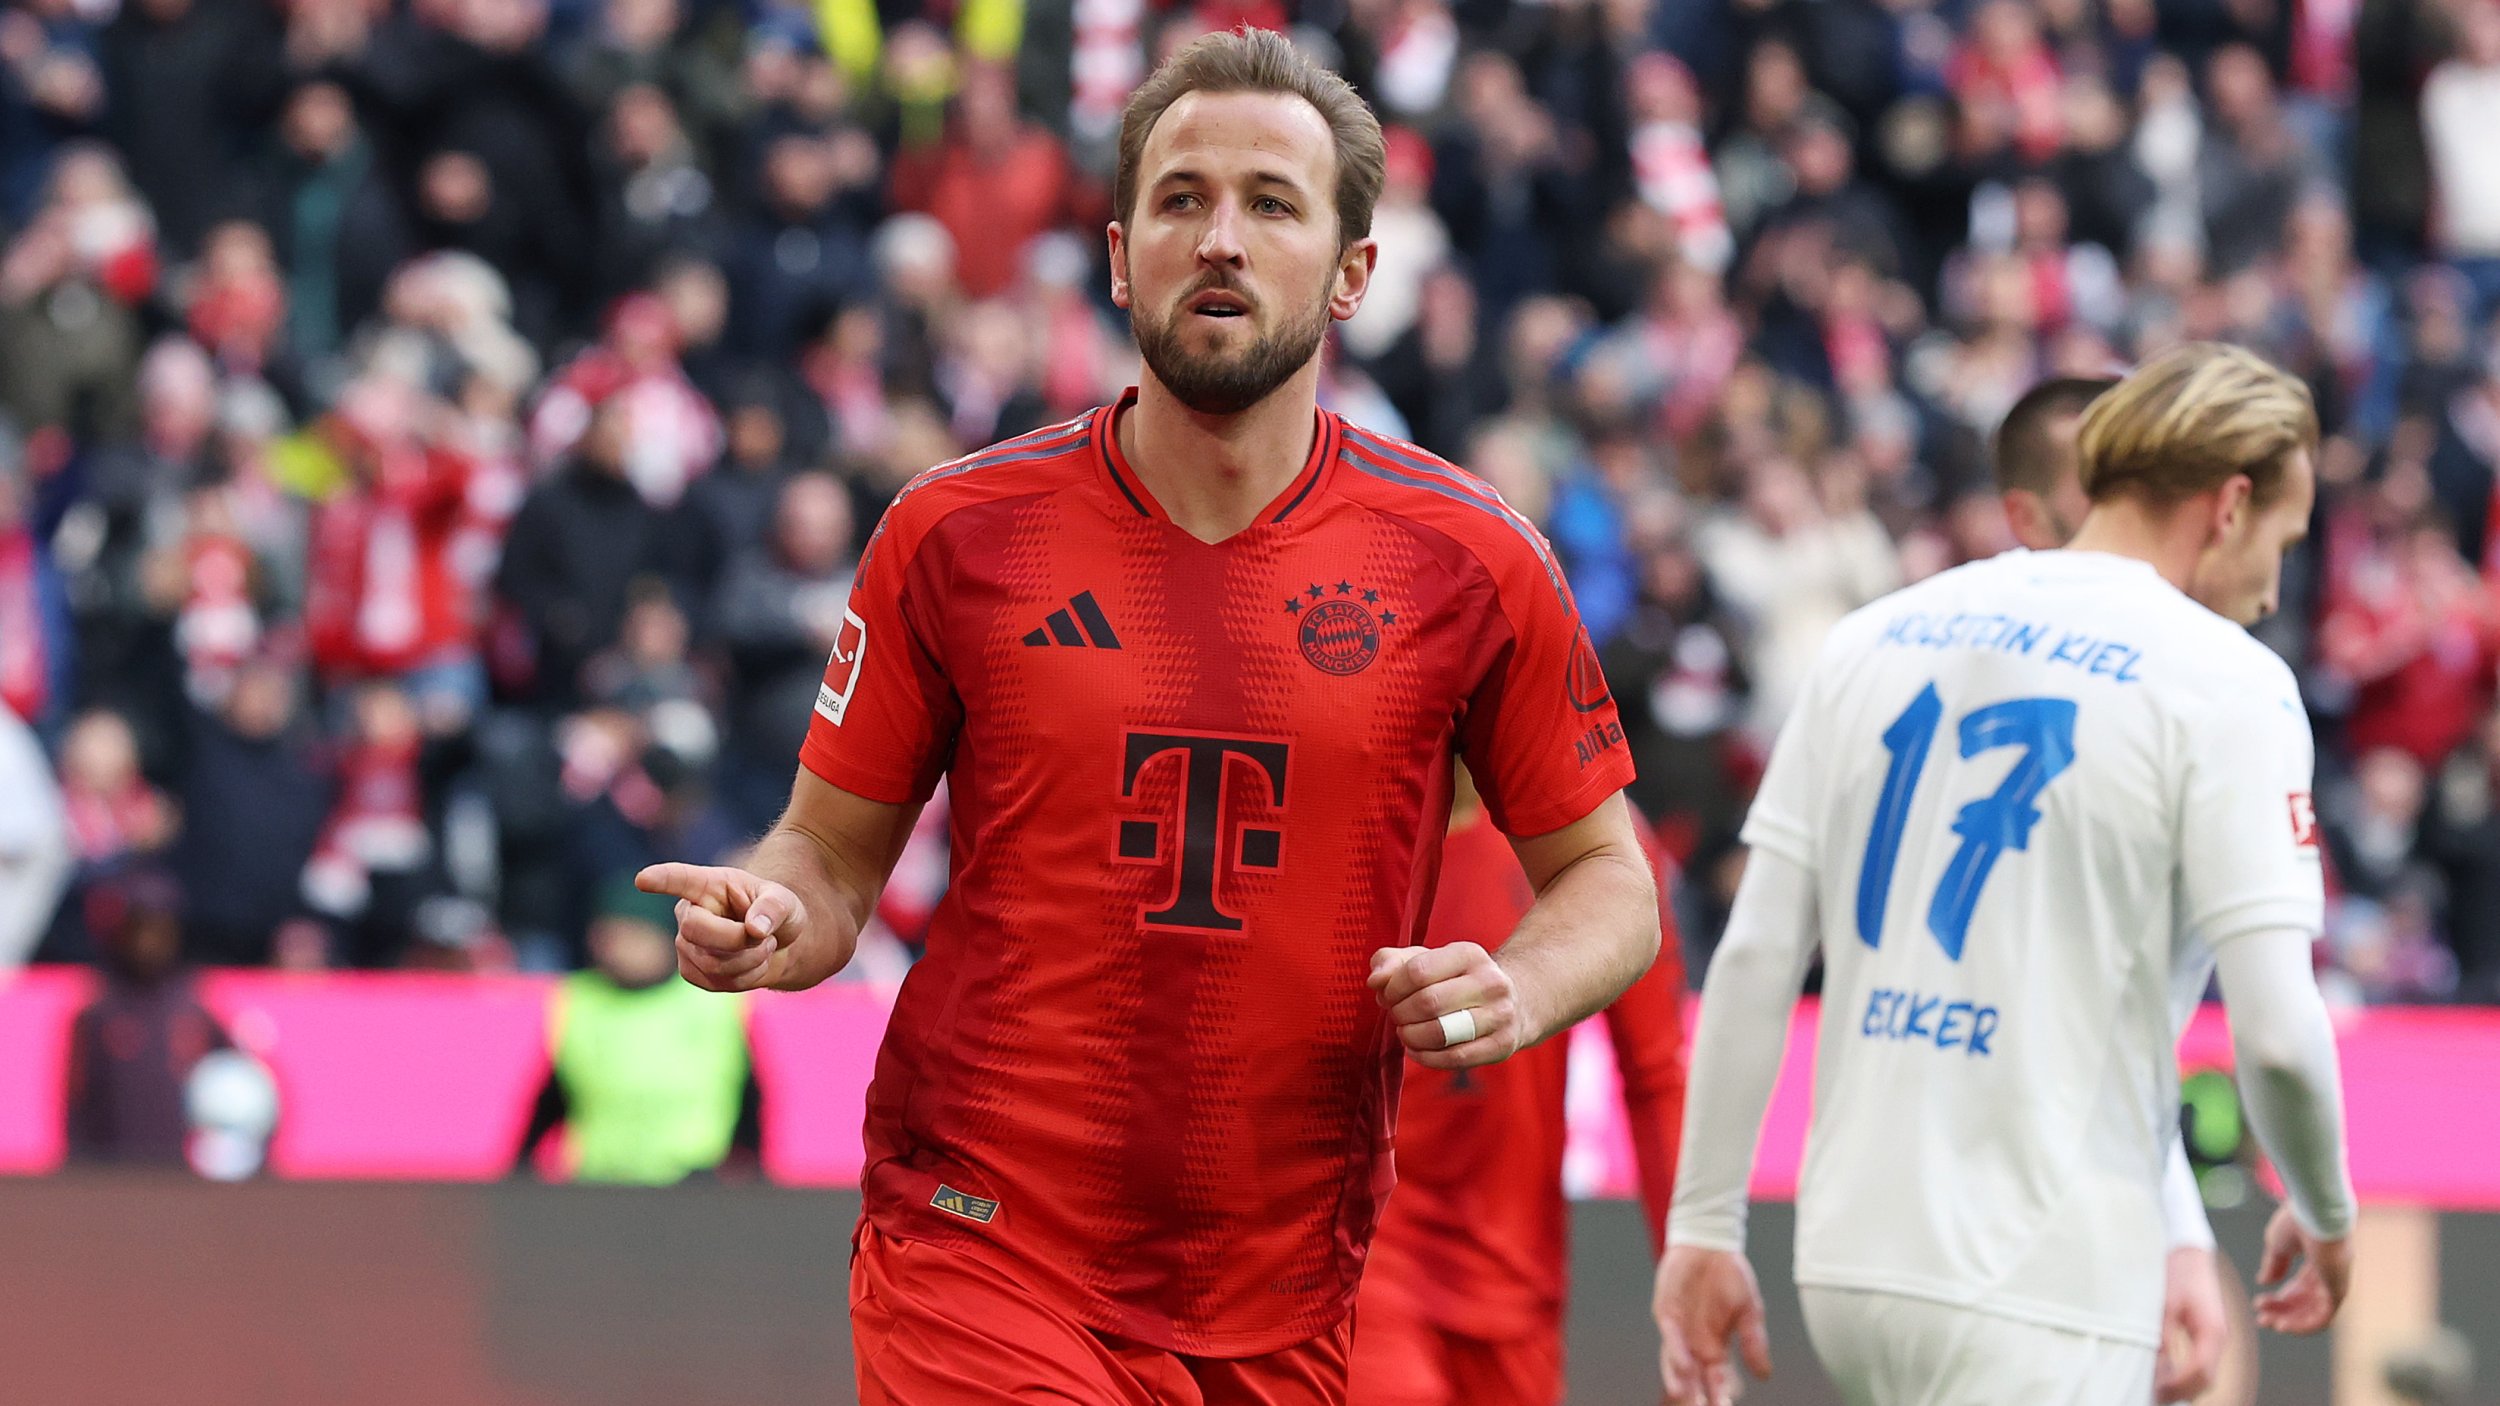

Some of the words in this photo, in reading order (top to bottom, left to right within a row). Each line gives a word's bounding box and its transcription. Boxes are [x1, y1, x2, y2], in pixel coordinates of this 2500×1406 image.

[1307, 613, 1322, 629] FC
[1324, 605, 1372, 635] BAYERN
[2048, 634, 2142, 682] KIEL
[1573, 721, 1624, 770] Allia
[1112, 726, 1297, 938] T
[1856, 681, 2078, 963] 17
